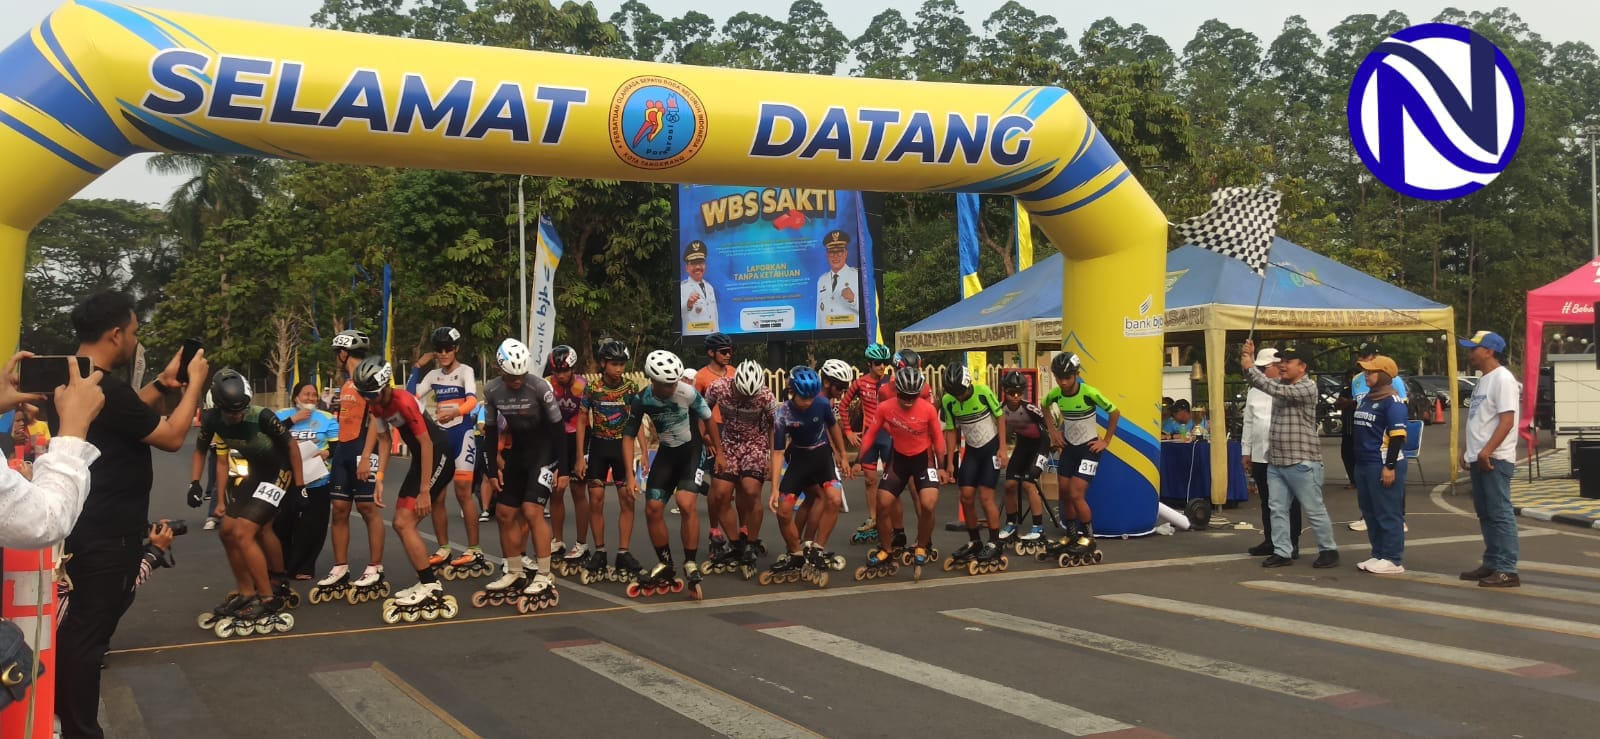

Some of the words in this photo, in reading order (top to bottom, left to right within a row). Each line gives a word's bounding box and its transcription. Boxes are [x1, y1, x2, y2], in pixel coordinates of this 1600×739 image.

[640, 76, 663, 84] SEPATU
[616, 80, 641, 104] OLAHRAGA
[681, 88, 702, 113] SELURUH
[143, 48, 588, 145] SELAMAT
[749, 101, 1035, 166] DATANG
[612, 106, 621, 143] PERSATUAN
[693, 113, 705, 148] INDONESIA
[623, 152, 639, 165] KOTA
[641, 155, 685, 168] TANGERANG
[701, 191, 759, 229] WBS
[762, 188, 837, 214] SAKTI
[734, 272, 758, 281] TANPA
[760, 268, 801, 280] KETAHUAN
[746, 263, 788, 273] LAPORKAN
[1035, 320, 1063, 336] KEC
[1125, 316, 1151, 330] bank
[1257, 309, 1344, 328] KECAMATAN
[1347, 310, 1422, 328] NEGLASARI
[900, 333, 956, 348] KECAMATAN
[957, 324, 1017, 344] NEGLASARI
[257, 485, 281, 502] 440
